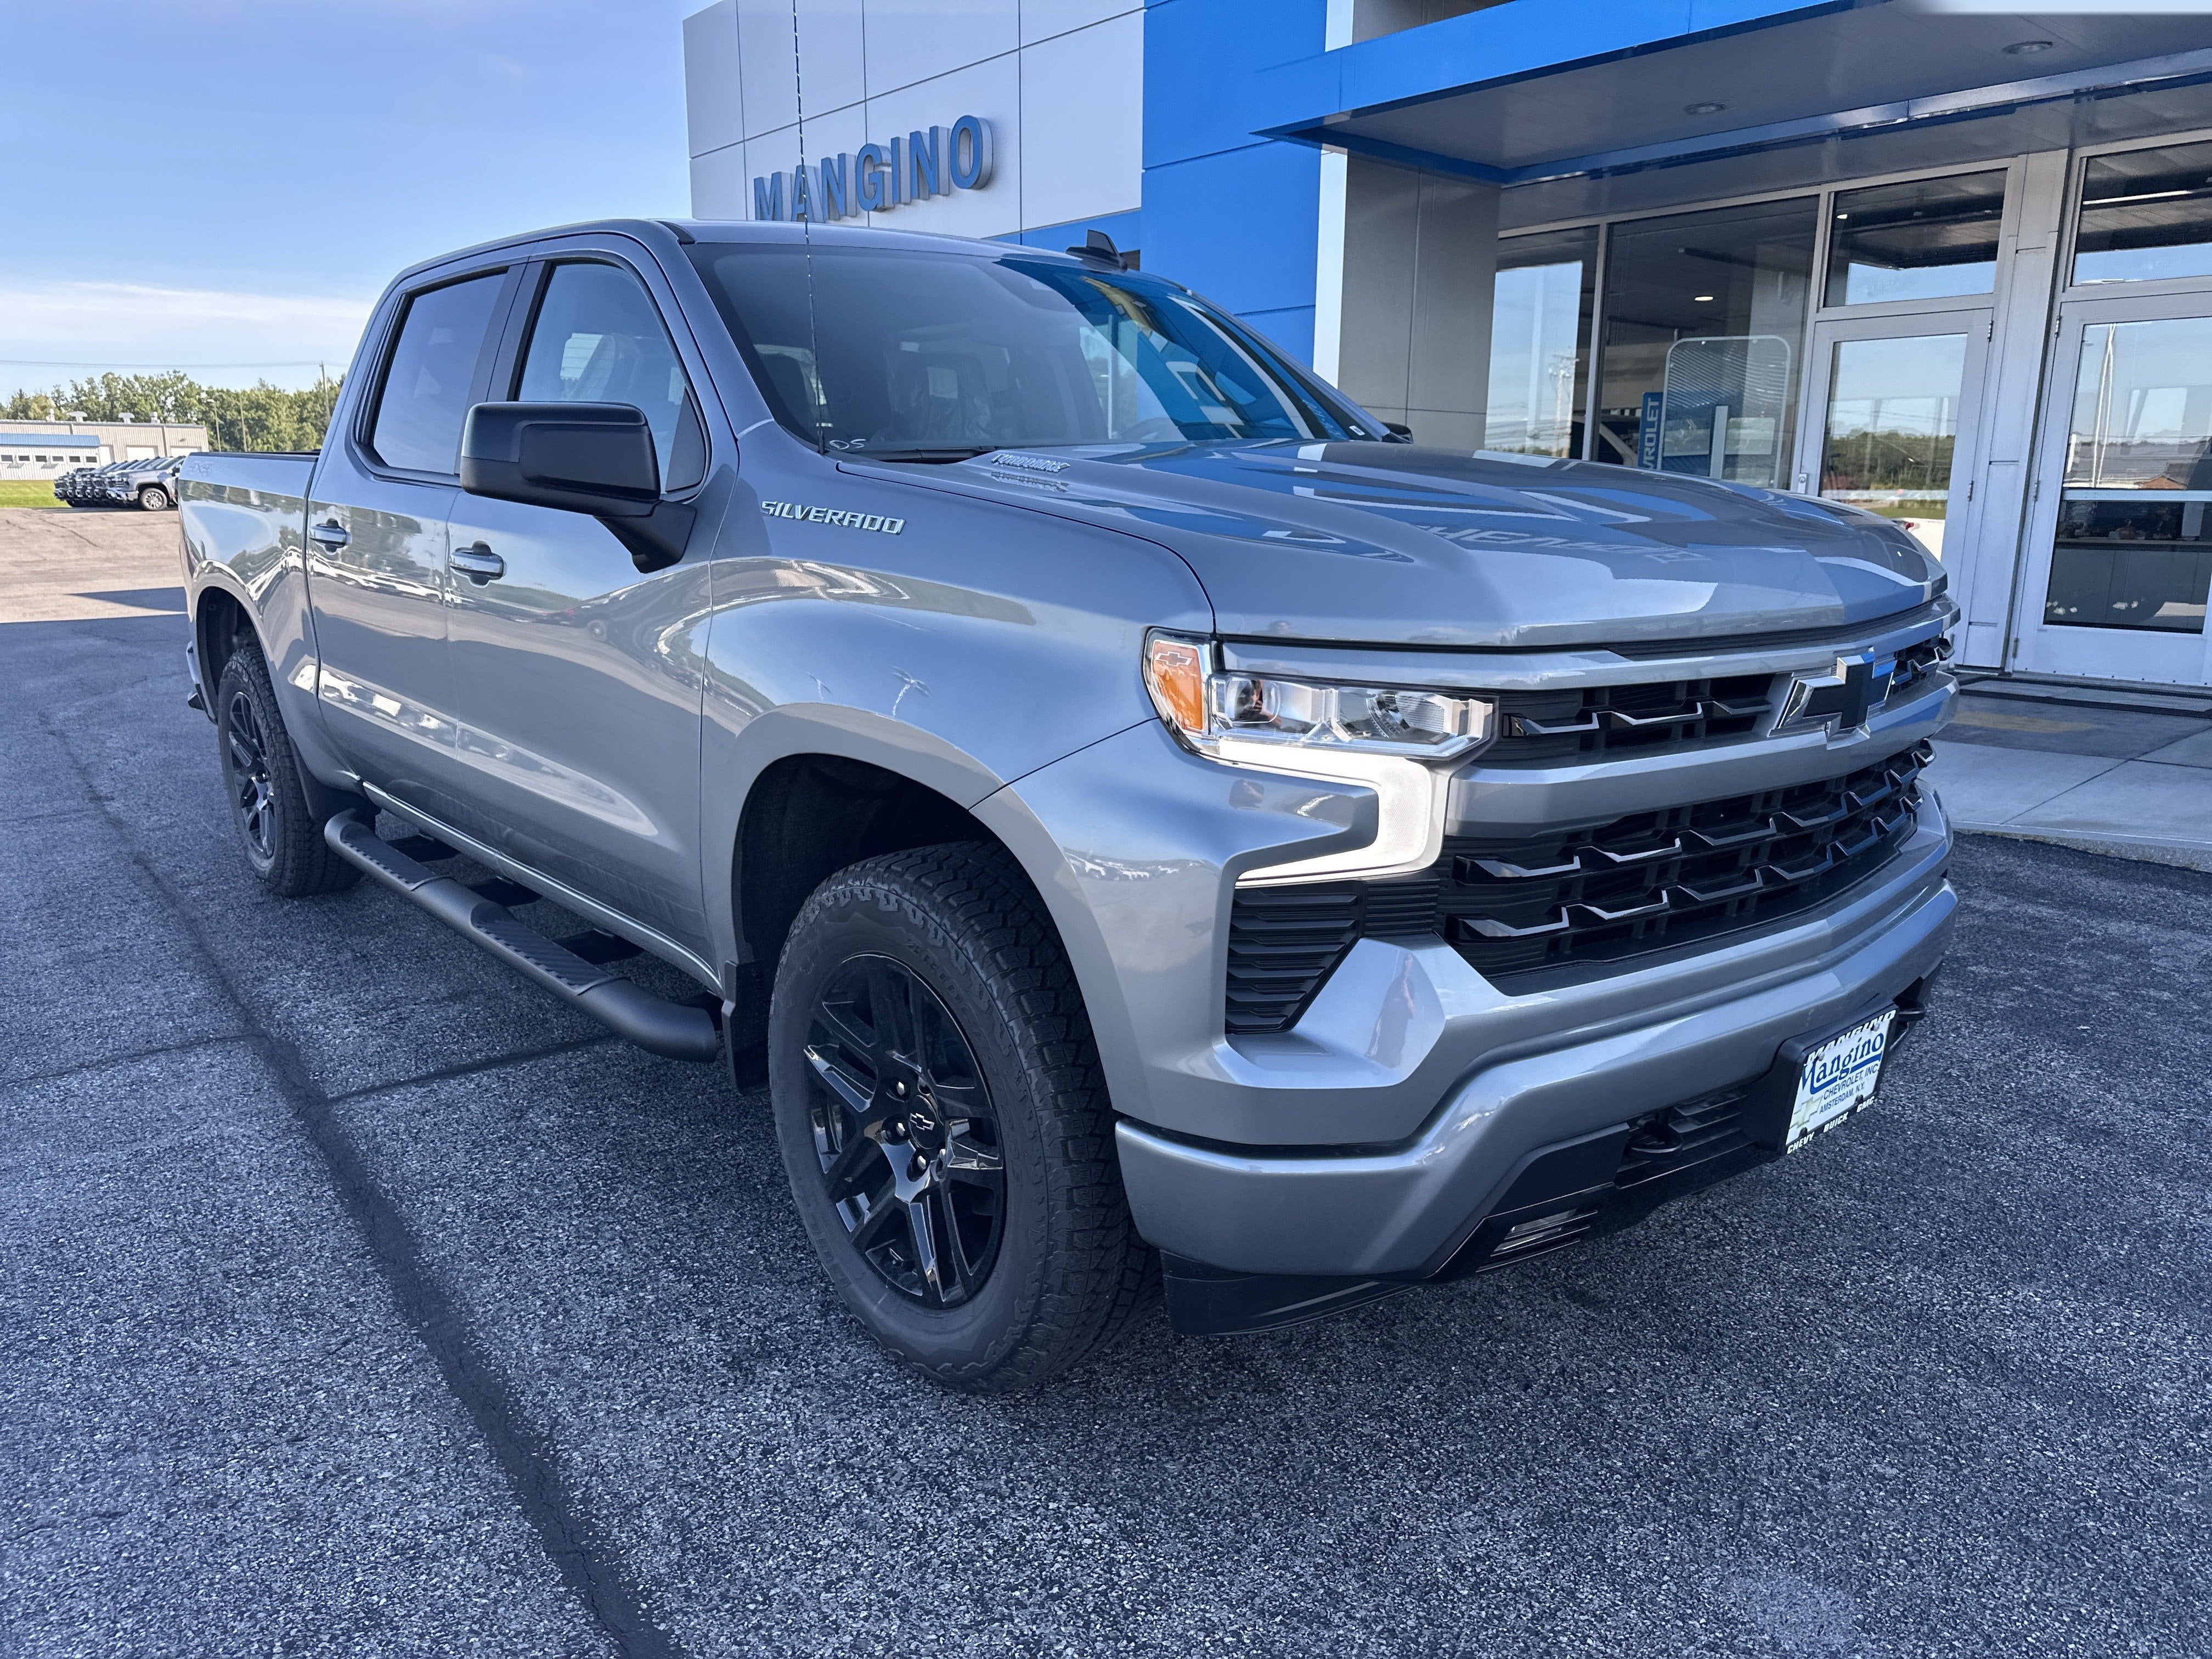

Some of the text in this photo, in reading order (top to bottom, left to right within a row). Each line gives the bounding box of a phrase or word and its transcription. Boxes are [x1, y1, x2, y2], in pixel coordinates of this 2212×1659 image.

[754, 115, 992, 221] MANGINO
[760, 500, 906, 536] SILVERADO
[1802, 1032, 1884, 1095] Mangino
[1787, 1096, 1875, 1154] CHEVY BUICK GMC
